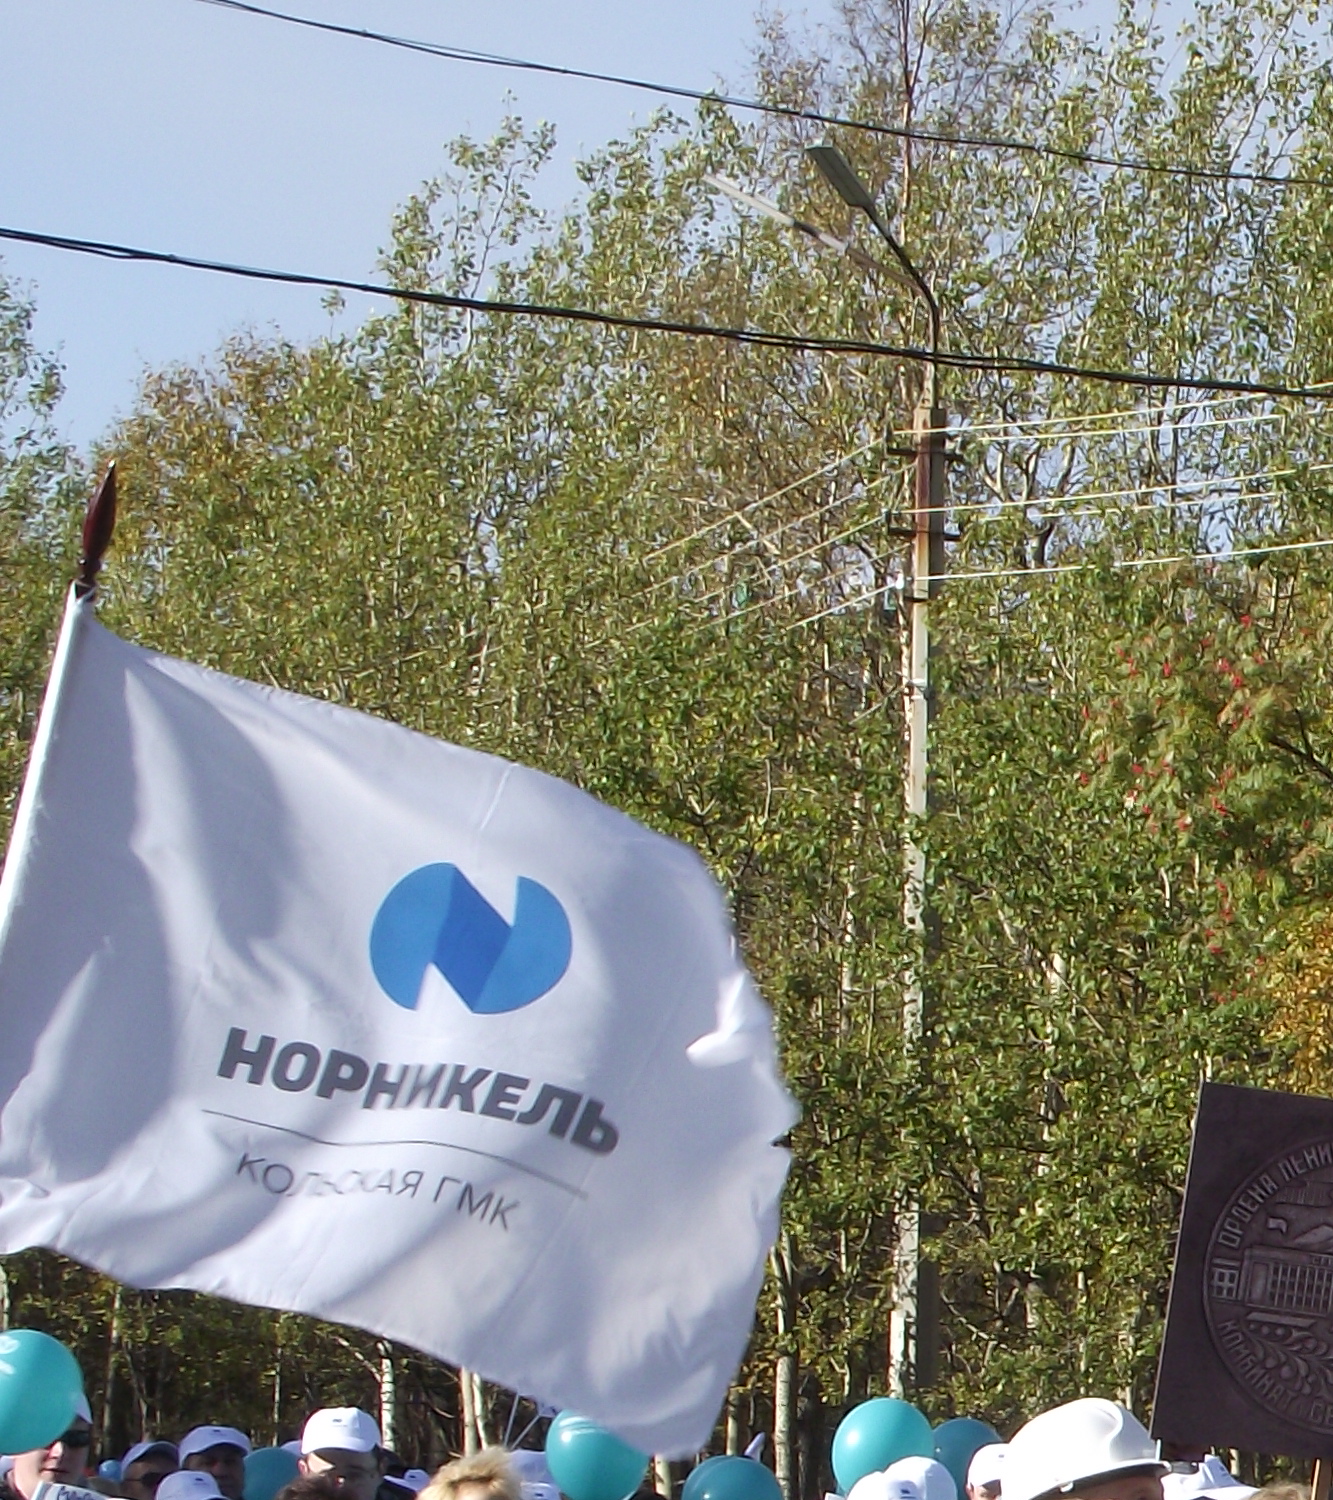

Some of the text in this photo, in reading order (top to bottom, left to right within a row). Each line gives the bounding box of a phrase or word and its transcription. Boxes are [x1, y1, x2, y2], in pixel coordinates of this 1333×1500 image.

[216, 1027, 620, 1156] НОРНИКЕЛЬ
[235, 1151, 521, 1232] КОЛЬСКАЯ ГМК
[1217, 1171, 1278, 1248] ОРДЕНА
[1217, 1319, 1297, 1413] КОМБИНАТ
